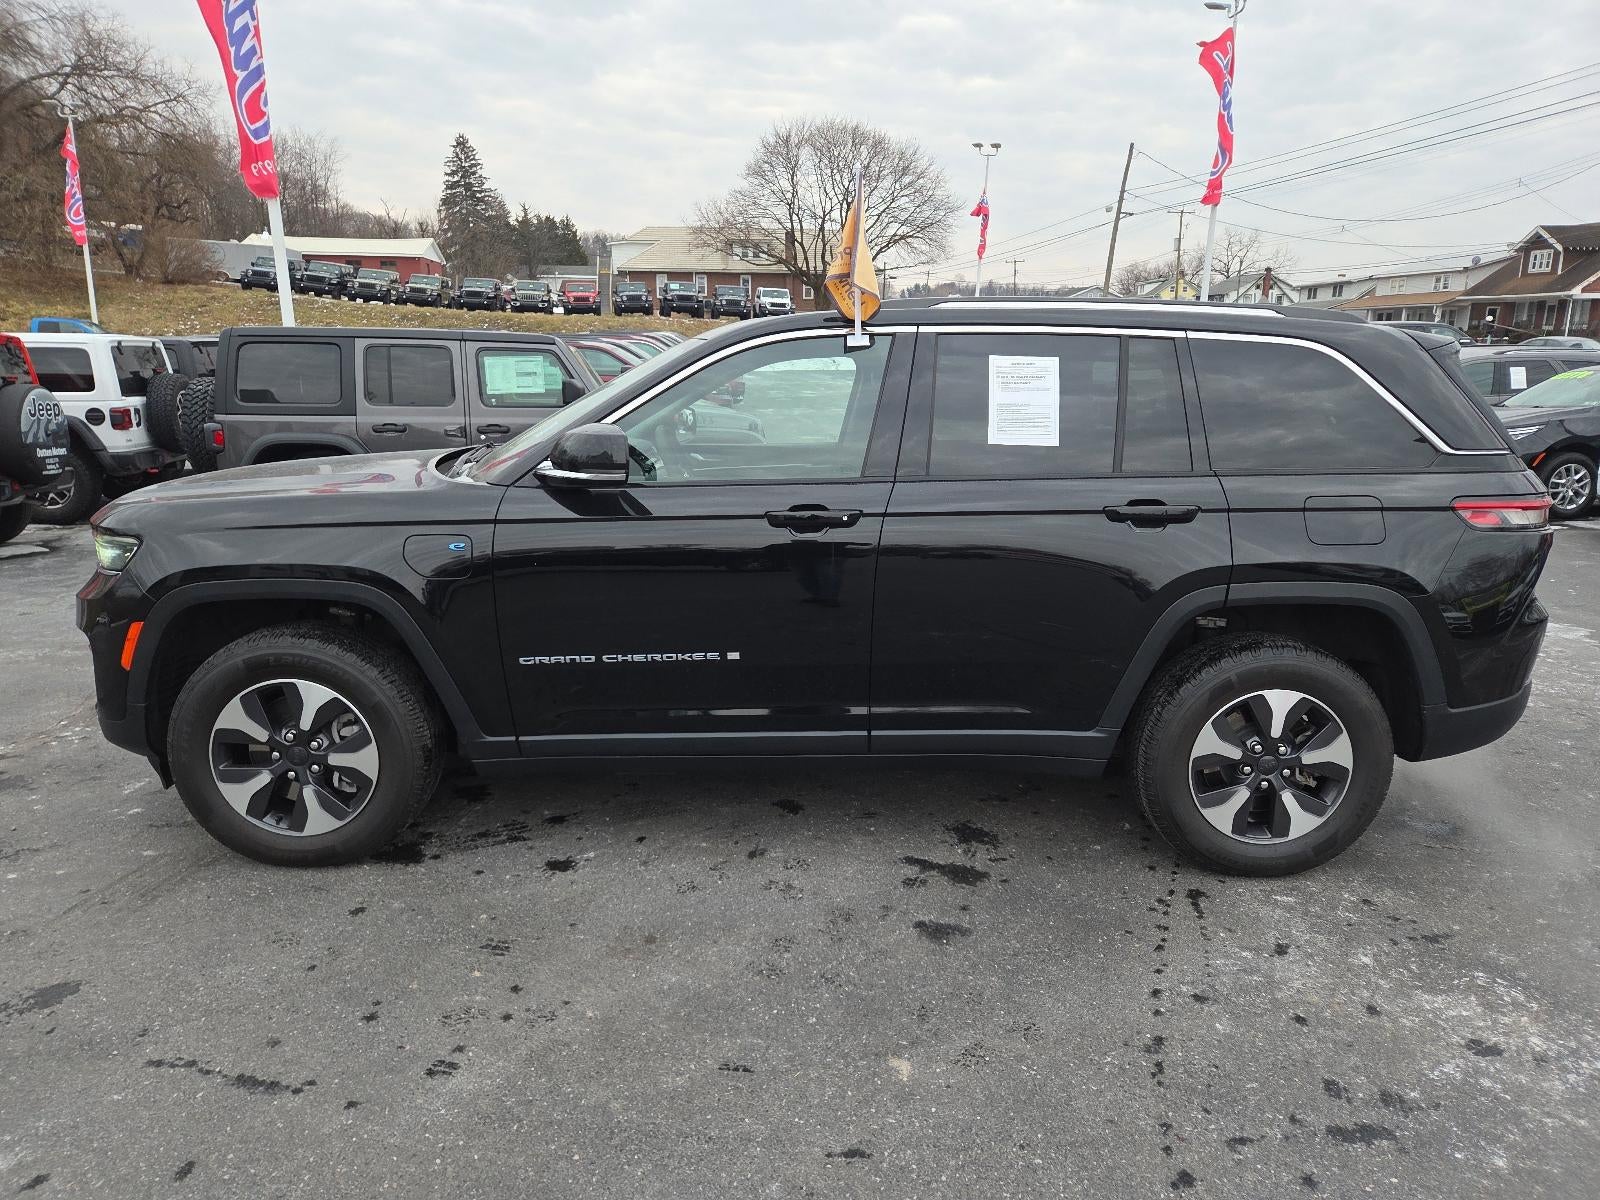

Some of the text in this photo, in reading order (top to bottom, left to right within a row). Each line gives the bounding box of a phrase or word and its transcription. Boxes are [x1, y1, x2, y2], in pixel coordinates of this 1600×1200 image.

[27, 396, 62, 423] Jeep
[519, 652, 721, 665] GRAND CHEROKEE
